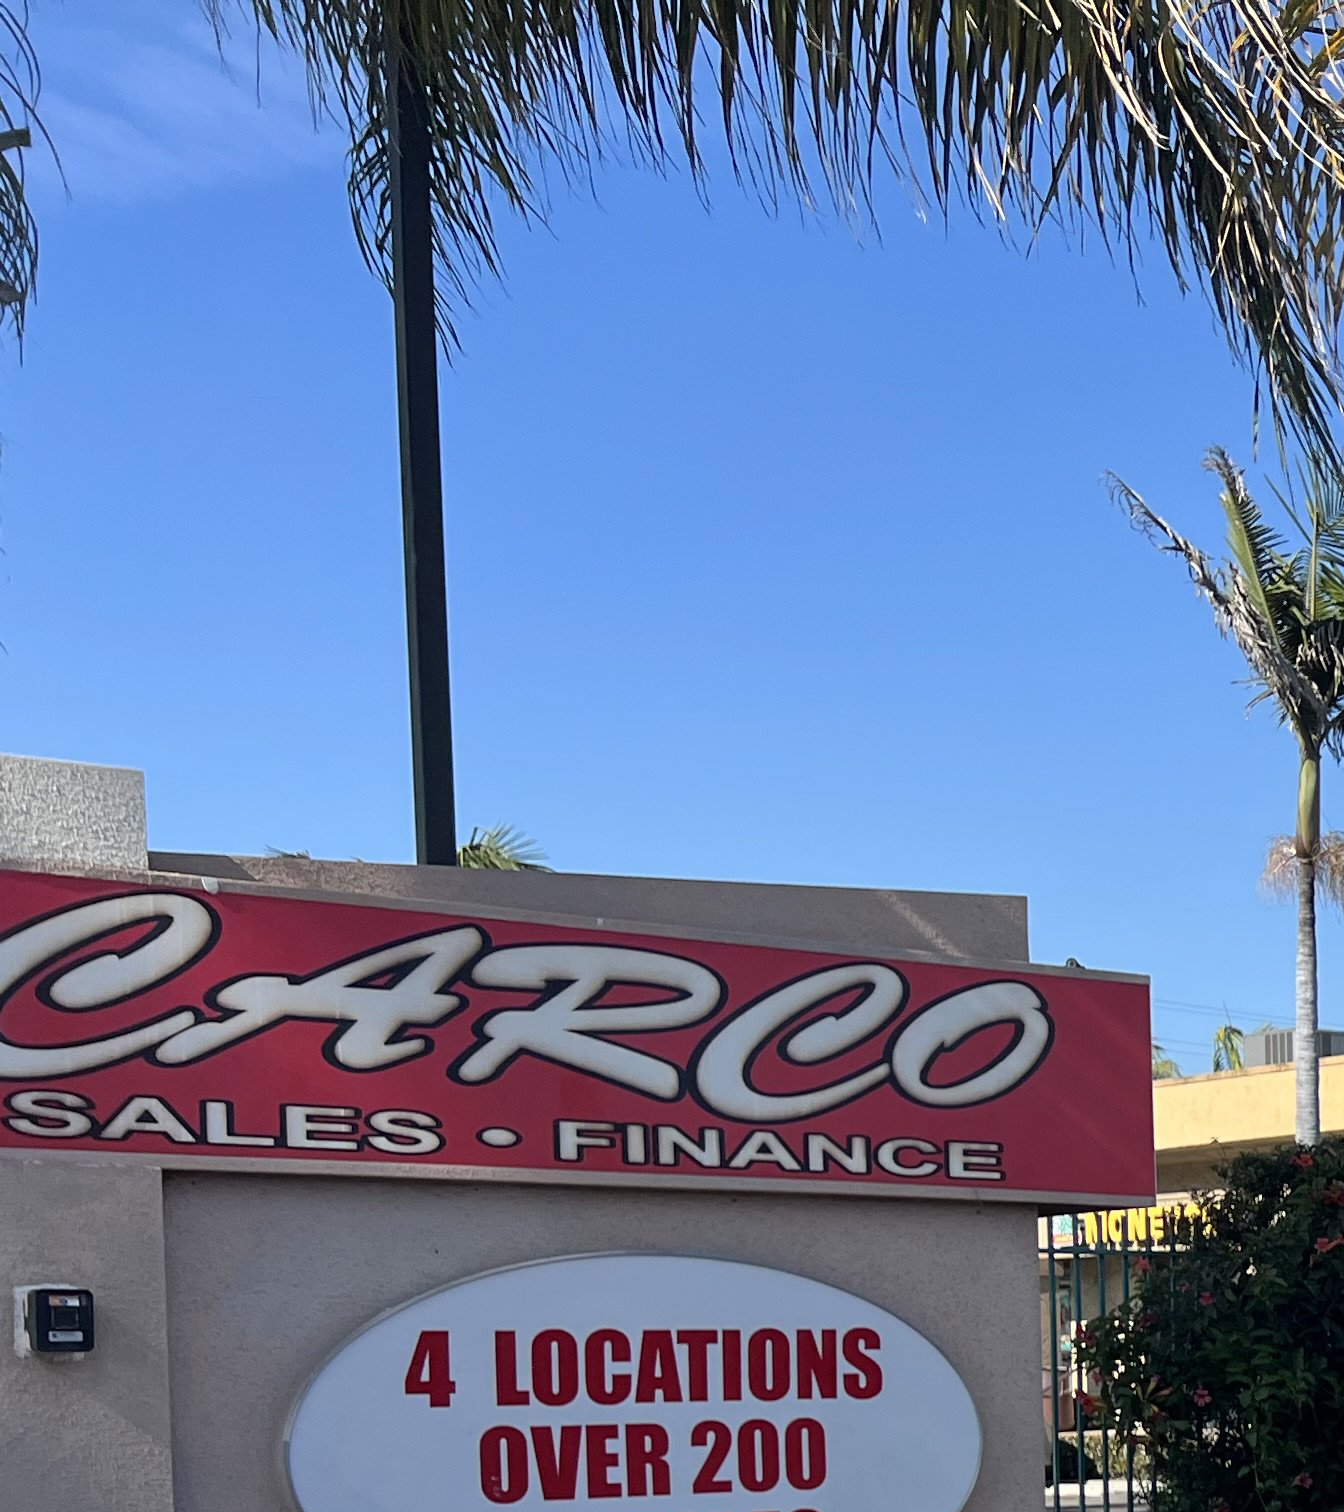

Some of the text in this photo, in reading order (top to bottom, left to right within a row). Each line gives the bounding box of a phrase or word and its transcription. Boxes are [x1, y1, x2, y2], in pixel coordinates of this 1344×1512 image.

[0, 893, 1053, 1122] CARCO
[4, 1091, 1005, 1180] SALES FINANCE
[404, 1328, 883, 1407] 4 LOCATIONS
[479, 1418, 827, 1504] OVER 200
